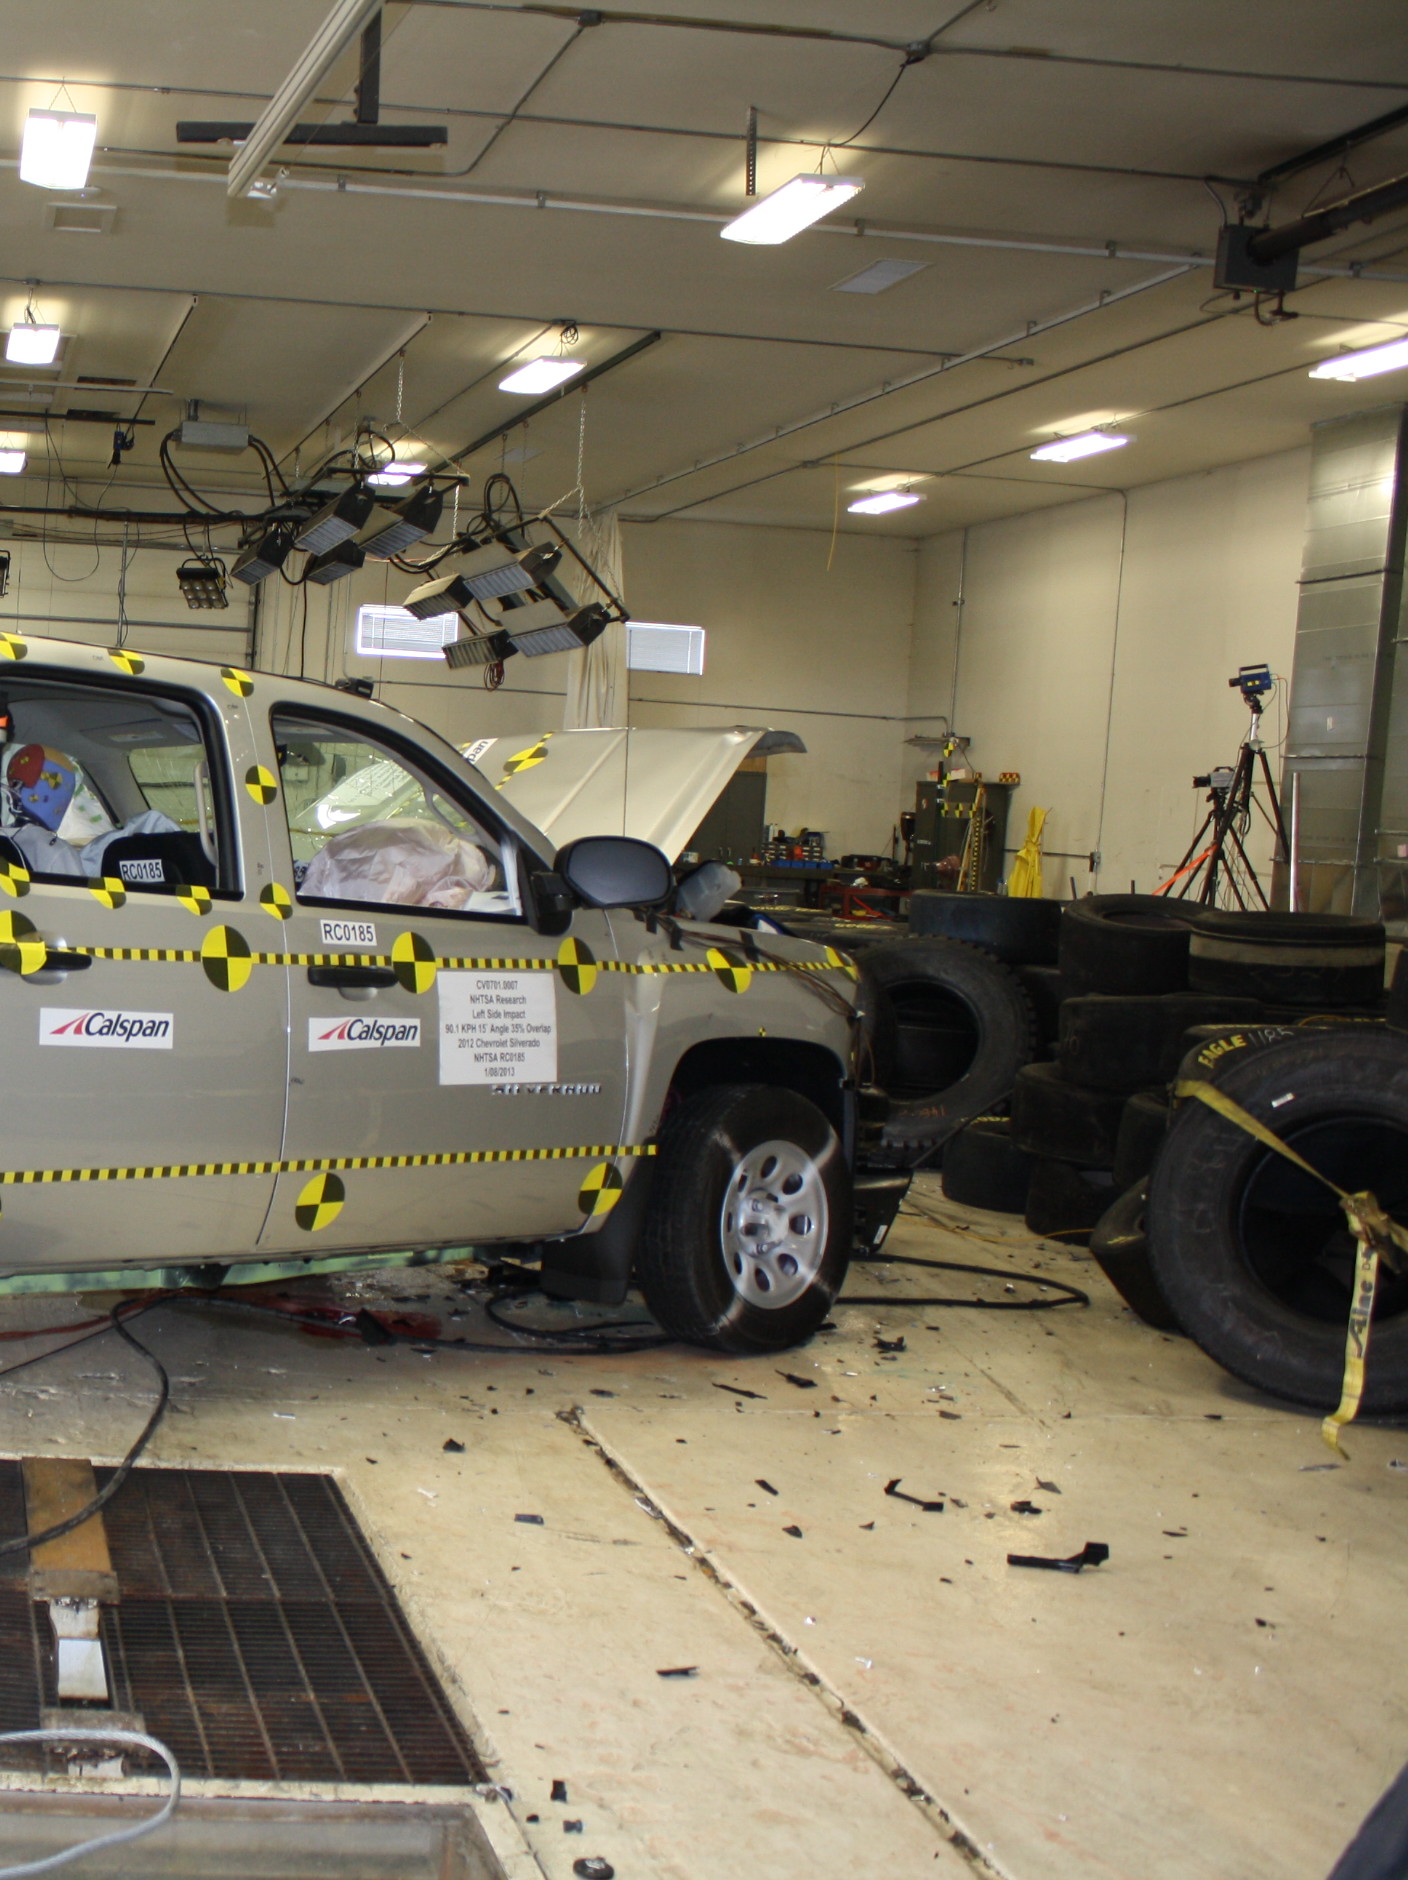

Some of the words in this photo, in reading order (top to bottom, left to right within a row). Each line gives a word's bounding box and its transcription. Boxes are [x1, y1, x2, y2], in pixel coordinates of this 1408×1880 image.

[121, 861, 162, 880] RC0185
[323, 923, 374, 942] RC0185
[469, 995, 494, 1005] NHTSA
[495, 995, 527, 1005] Research
[472, 1009, 486, 1019] Left
[487, 1009, 502, 1019] Side
[503, 1009, 526, 1020] Impact
[84, 1012, 170, 1043] Calspan
[346, 1018, 418, 1046] Calspan
[445, 1023, 460, 1034] 90.1
[461, 1024, 477, 1034] KPH
[490, 1023, 509, 1036] Angle
[511, 1023, 525, 1034] 35%
[526, 1023, 552, 1035] Overlap
[458, 1038, 474, 1048] 2012
[475, 1038, 508, 1048] Chevrolet
[509, 1038, 541, 1048] Silverado
[474, 1052, 498, 1062] NHTSA
[499, 1052, 526, 1063] RC0185
[1197, 1034, 1247, 1069] EAGLE
[484, 1067, 515, 1077] 1/08/2013
